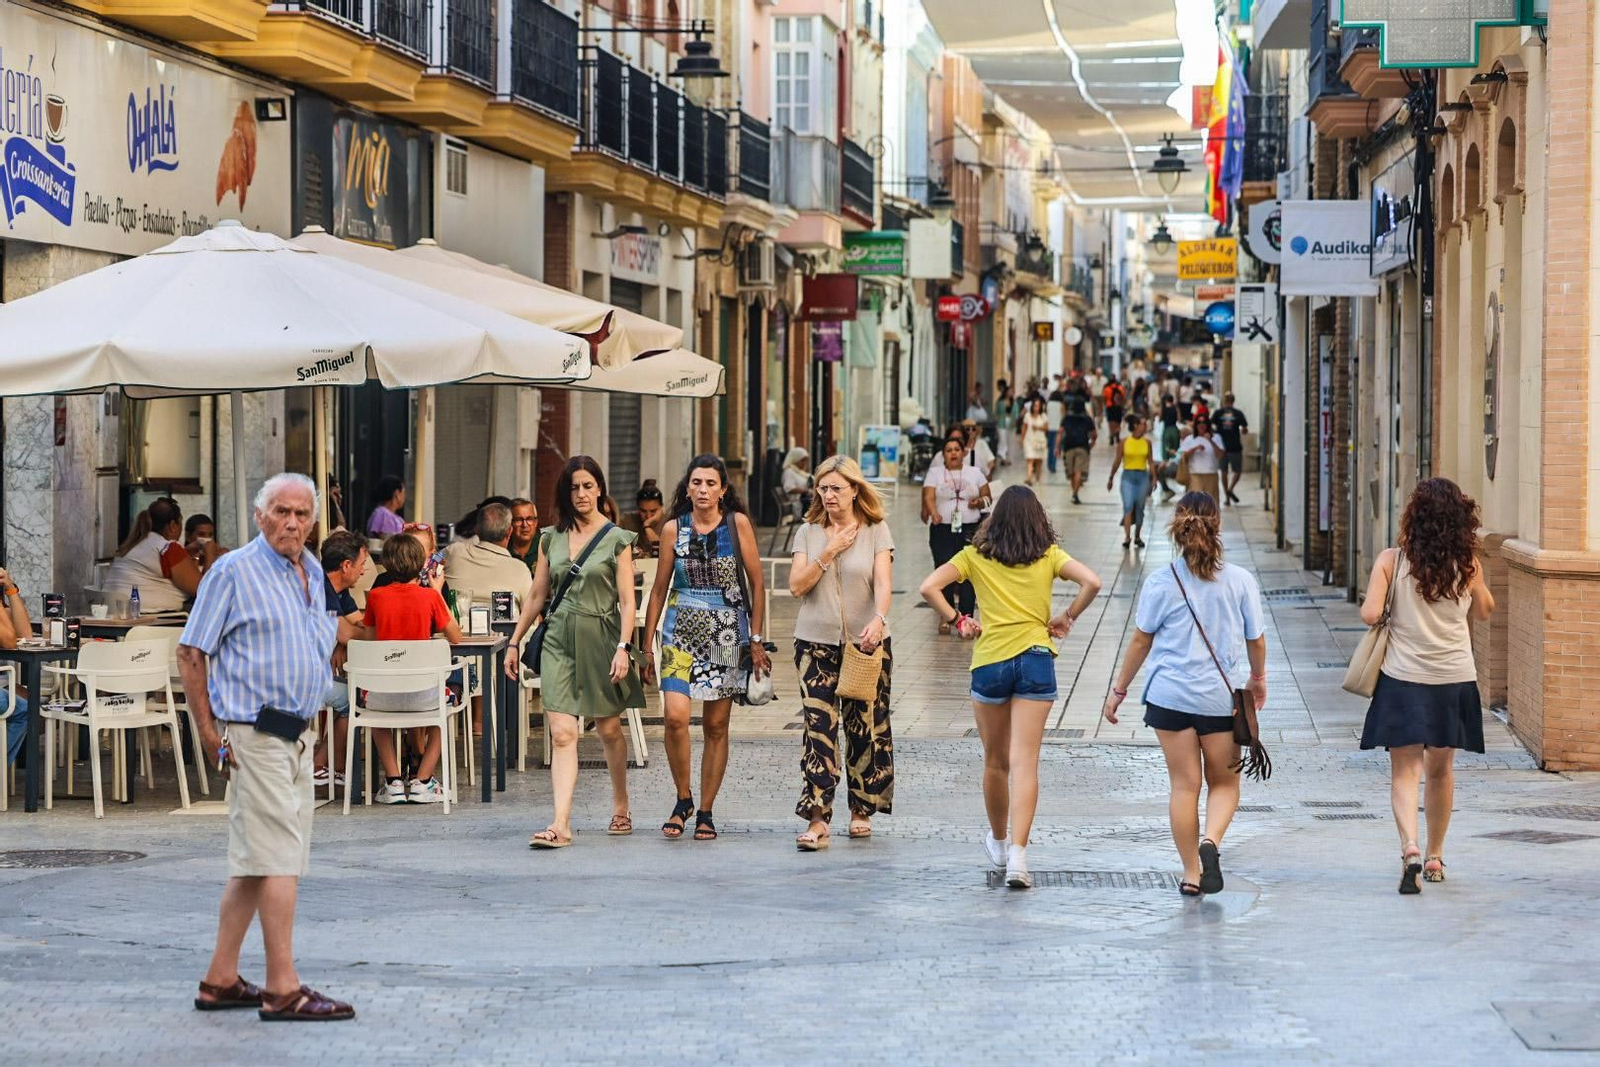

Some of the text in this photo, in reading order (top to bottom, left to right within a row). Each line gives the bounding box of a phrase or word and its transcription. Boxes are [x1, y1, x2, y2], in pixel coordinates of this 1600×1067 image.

[84, 191, 109, 224] Paellas
[115, 196, 137, 233] Pizzas
[142, 203, 176, 236] Ensaladas
[1311, 240, 1370, 254] Audika
